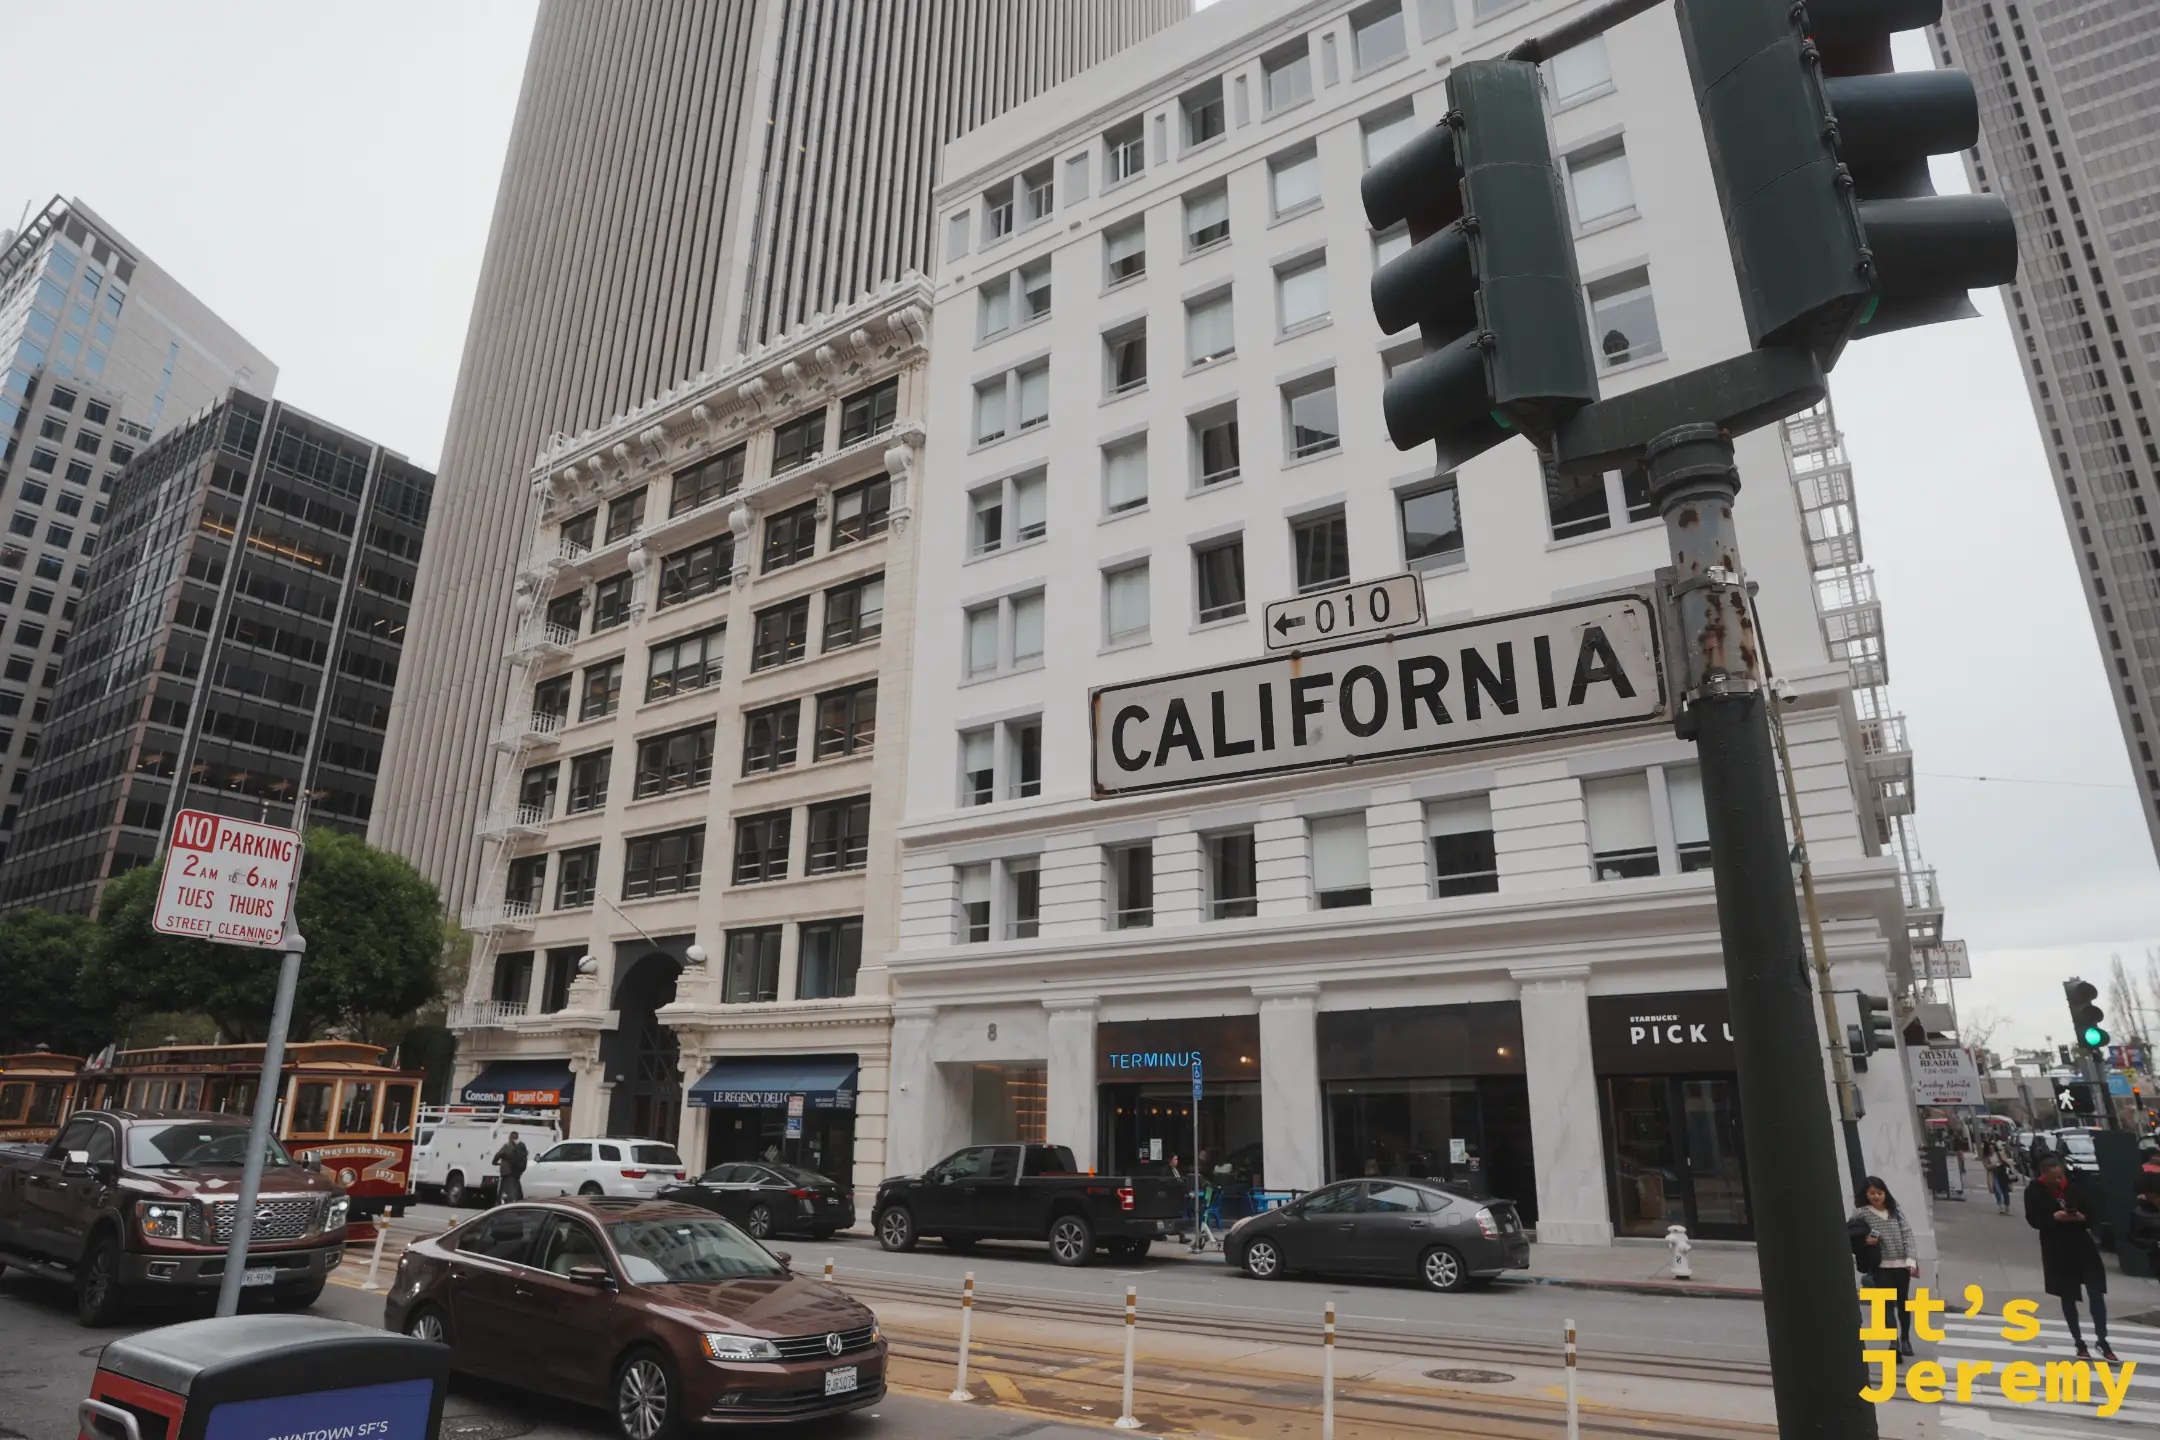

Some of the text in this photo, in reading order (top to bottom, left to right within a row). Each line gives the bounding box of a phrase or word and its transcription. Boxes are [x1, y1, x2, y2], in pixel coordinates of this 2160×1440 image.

[1315, 586, 1391, 634] 010
[1111, 625, 1638, 772] CALIFORNIA
[178, 814, 293, 863] NO PARKING
[177, 886, 274, 918] TUES THURS
[166, 915, 273, 940] STREET CLEANING
[1629, 1014, 1678, 1023] STARBUCKS
[987, 1022, 998, 1042] 8
[1630, 1024, 1708, 1045] PICK
[1110, 1051, 1202, 1069] TERMINUS
[1918, 1049, 1959, 1060] CRYSTAL
[1920, 1059, 1959, 1067] READER
[465, 1090, 554, 1104] Concentra Urgent Care
[713, 1091, 725, 1103] LE
[724, 1091, 763, 1103] REGENCY
[764, 1091, 783, 1103] DELI
[345, 1146, 355, 1154] to
[357, 1146, 372, 1155] the
[374, 1147, 396, 1157] Stars
[375, 1169, 395, 1180] 1873
[357, 1420, 389, 1436] SF'S
